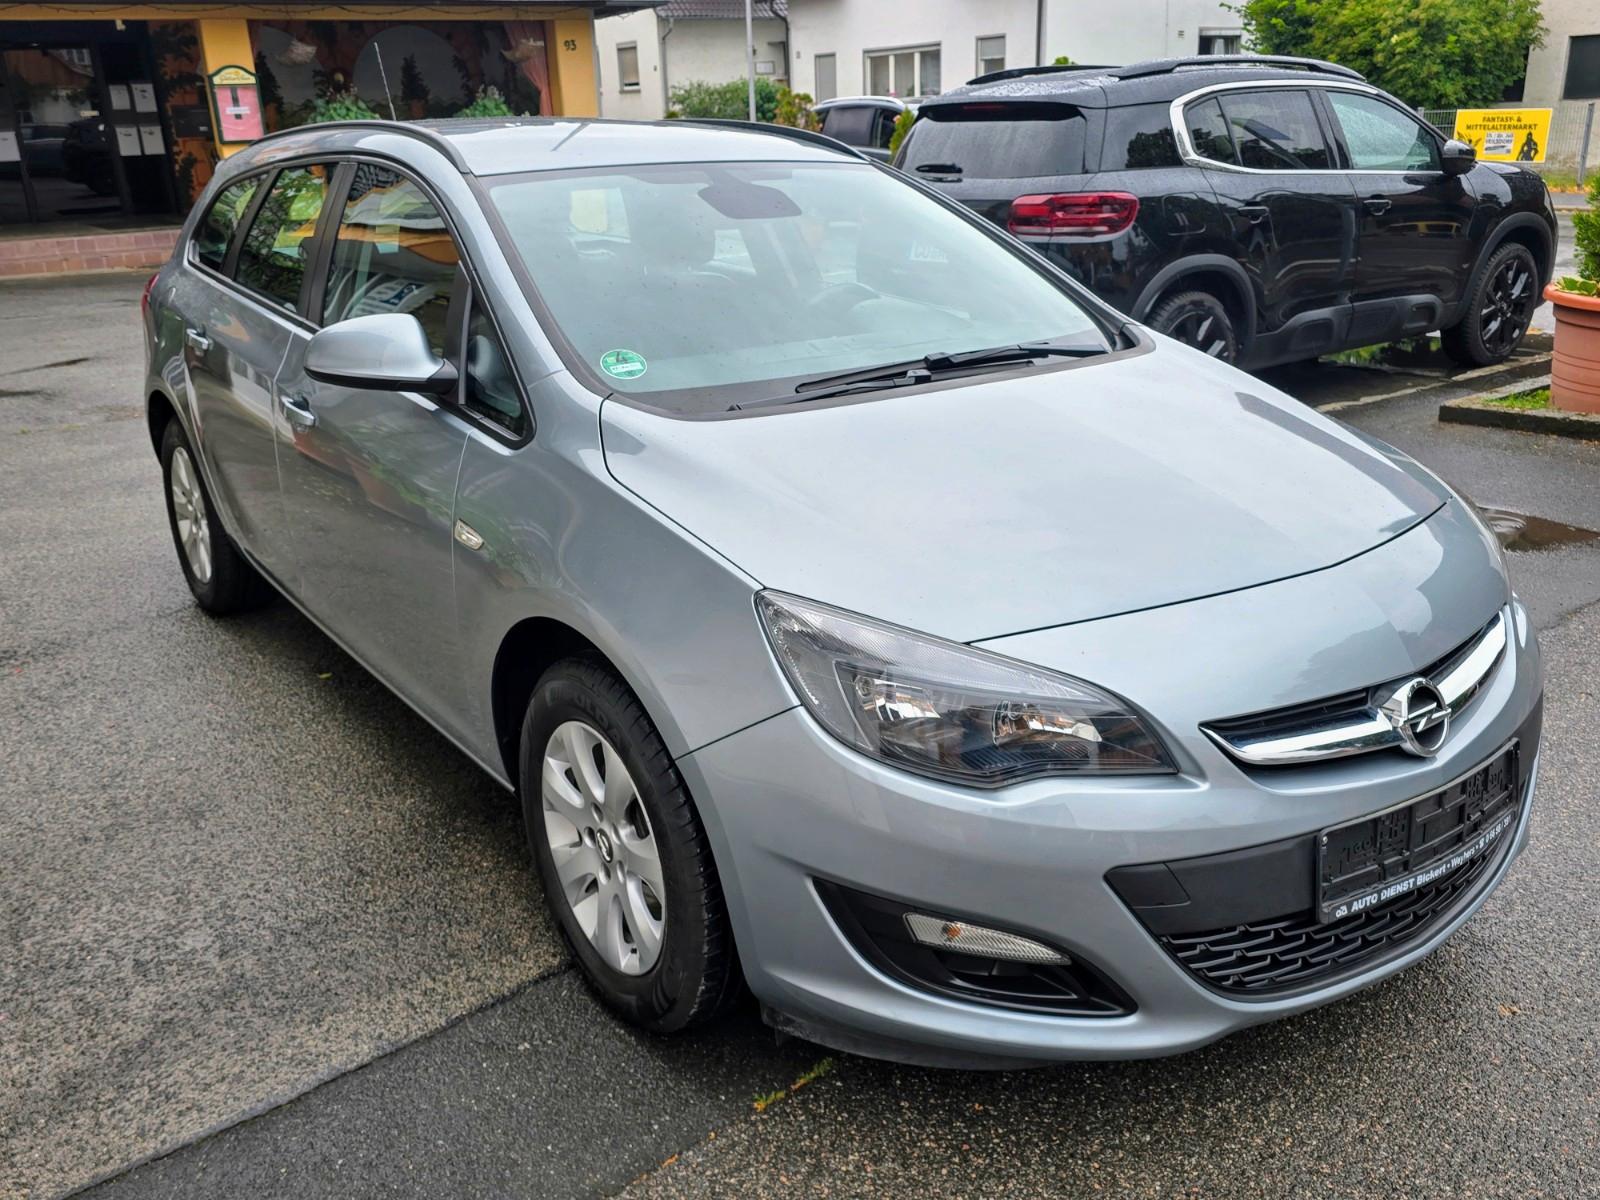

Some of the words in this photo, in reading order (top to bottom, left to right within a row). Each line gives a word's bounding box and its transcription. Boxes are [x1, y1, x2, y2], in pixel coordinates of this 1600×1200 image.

[563, 39, 577, 51] 93
[1466, 123, 1538, 131] MITTELALTERMARKT
[1351, 893, 1378, 912] AUTO
[1380, 877, 1415, 900] DIENST
[1416, 863, 1446, 885] Bickert
